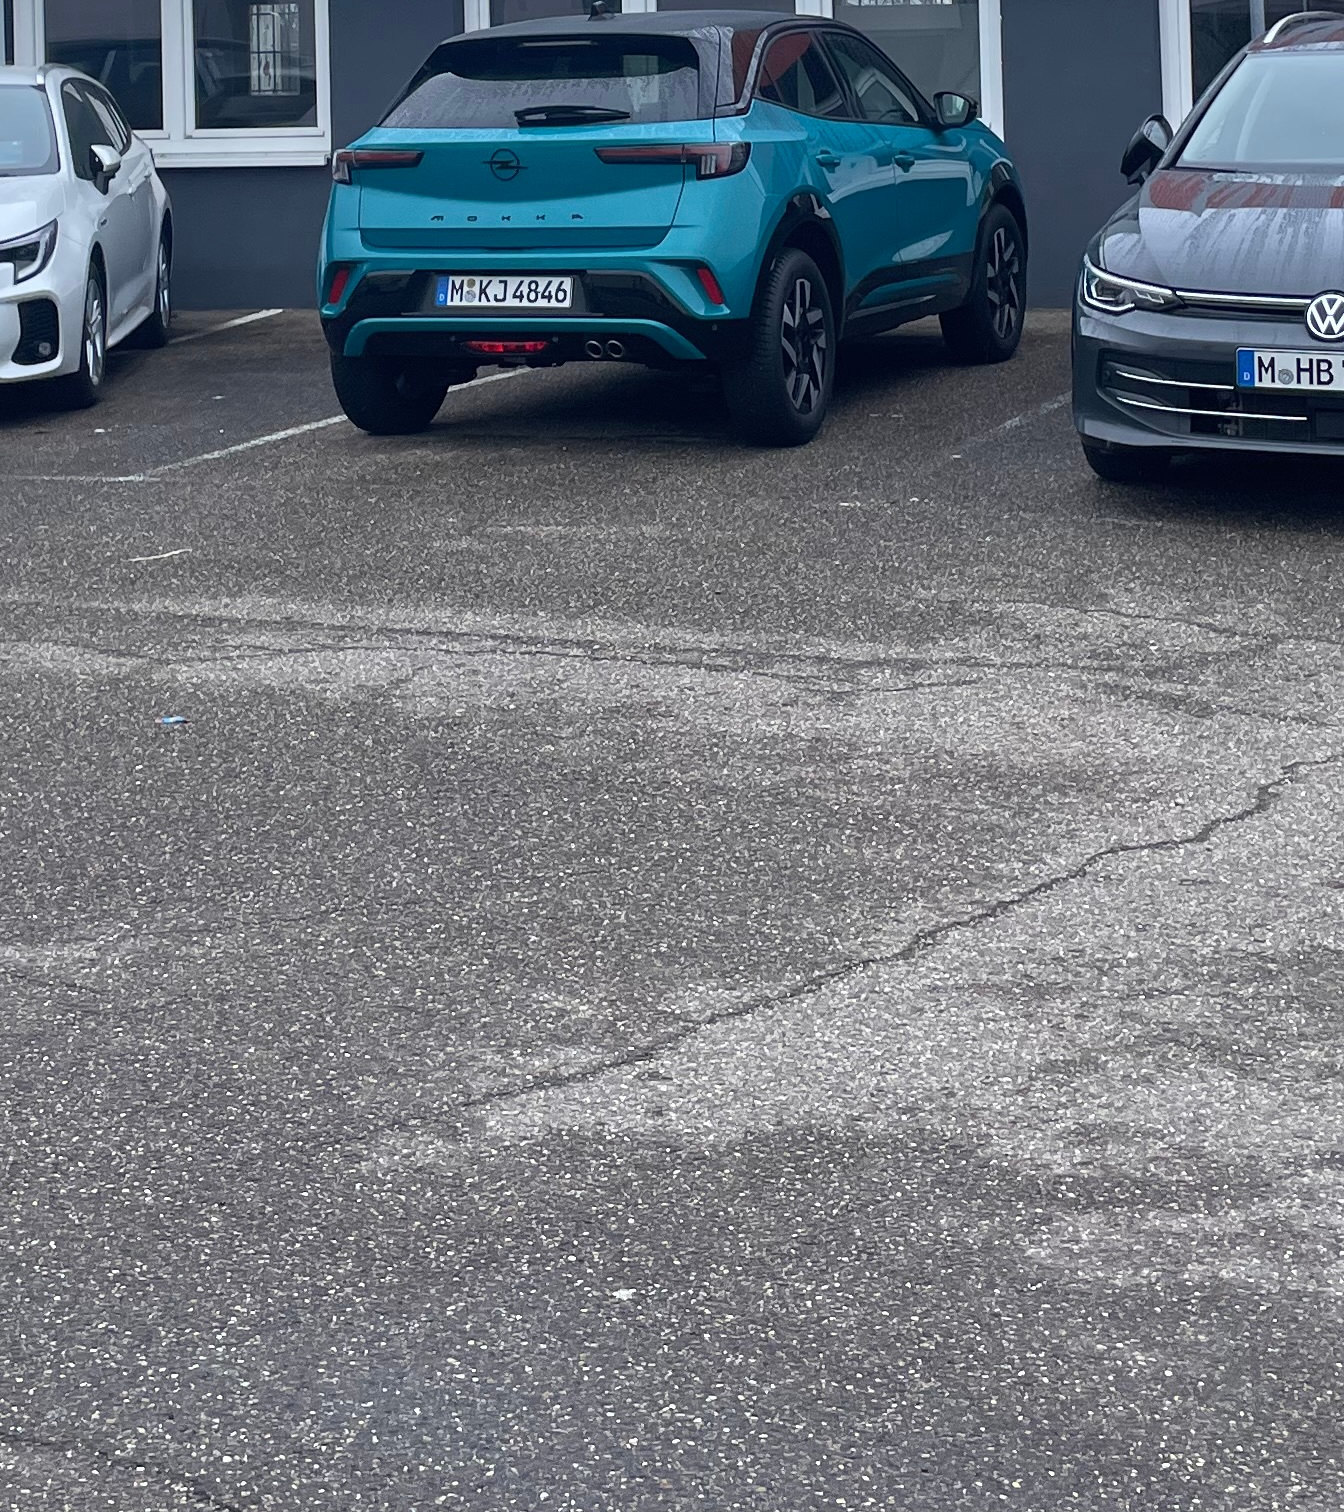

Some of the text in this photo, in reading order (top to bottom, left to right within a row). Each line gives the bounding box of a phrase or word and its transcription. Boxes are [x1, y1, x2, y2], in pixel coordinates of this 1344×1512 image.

[438, 279, 568, 304] D M KJ 4846
[1243, 371, 1251, 381] D
[1257, 356, 1275, 383] M
[1296, 357, 1334, 386] HB
